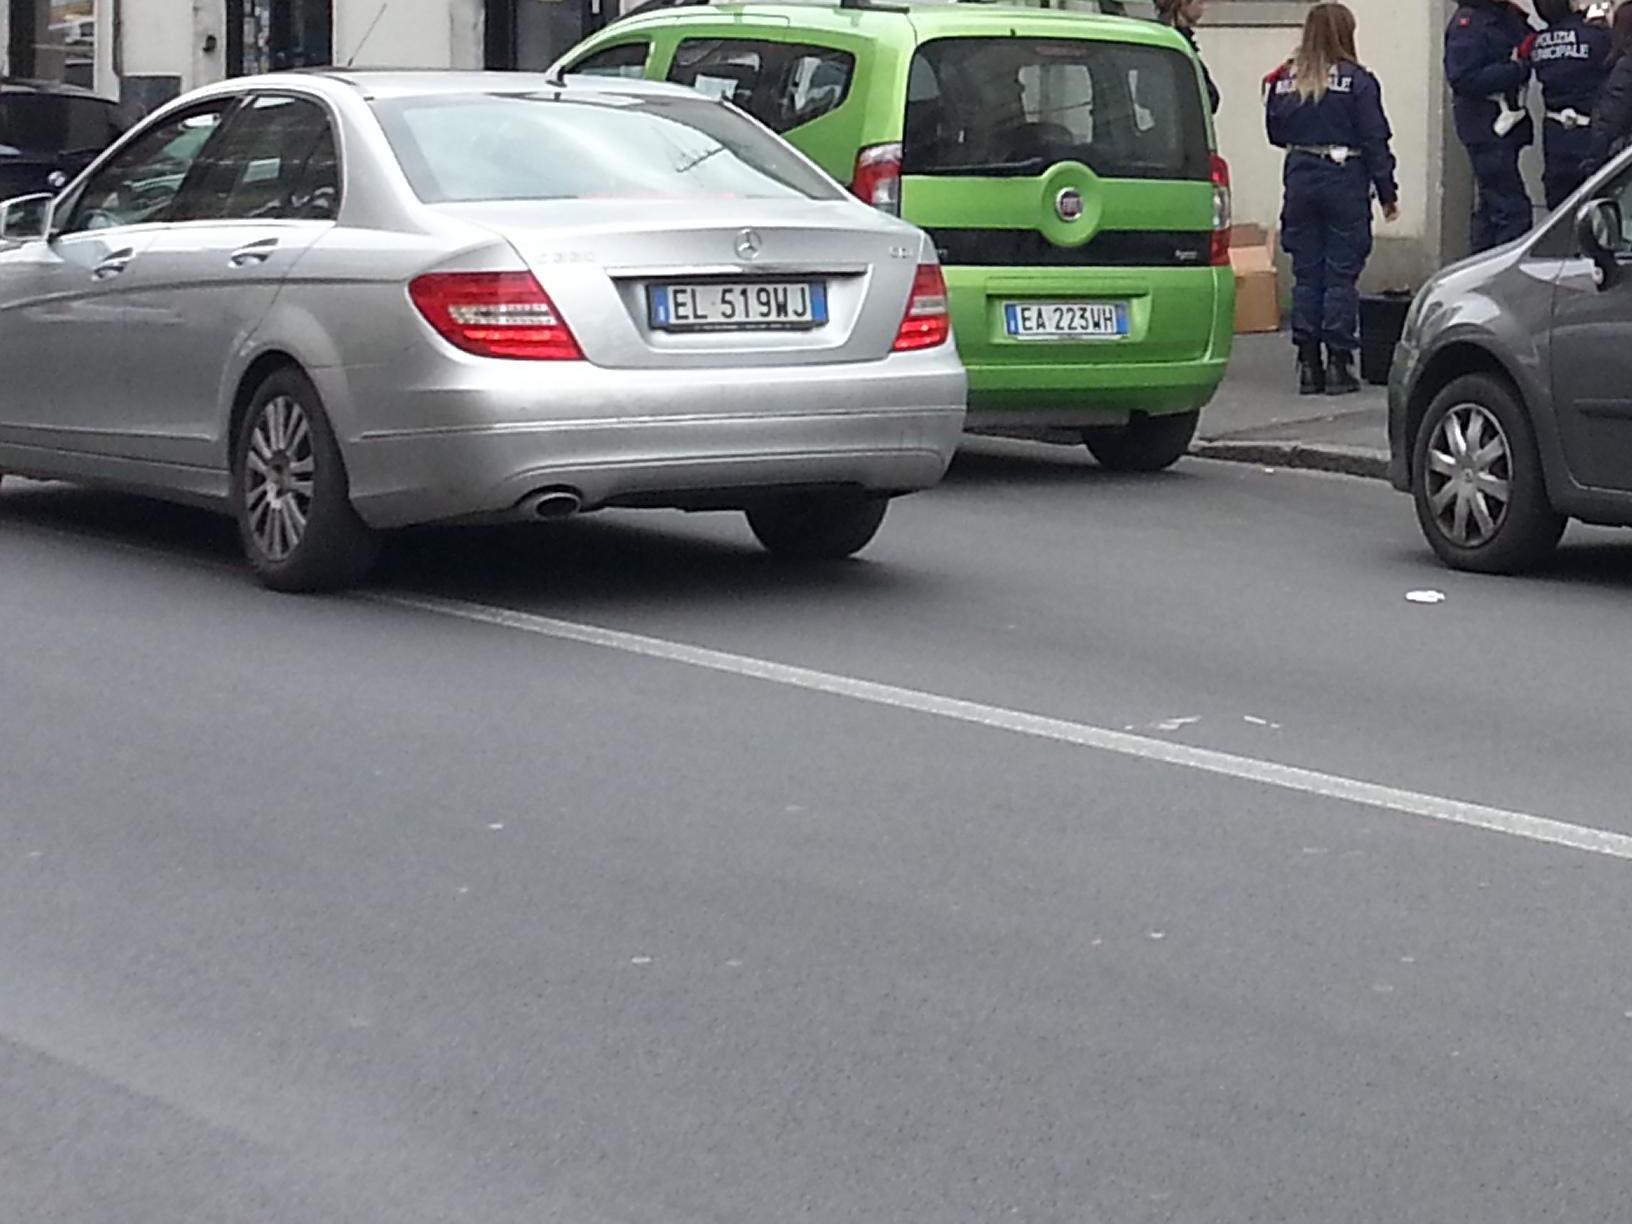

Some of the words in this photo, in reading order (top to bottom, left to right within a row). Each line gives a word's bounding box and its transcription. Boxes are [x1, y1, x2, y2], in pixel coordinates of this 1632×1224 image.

[1533, 29, 1576, 46] POLIZIA
[1531, 43, 1589, 62] UNICIPALE
[672, 288, 708, 321] EL
[721, 286, 807, 319] 519WJ
[1021, 307, 1046, 331] EA
[1052, 307, 1114, 332] 223WH
